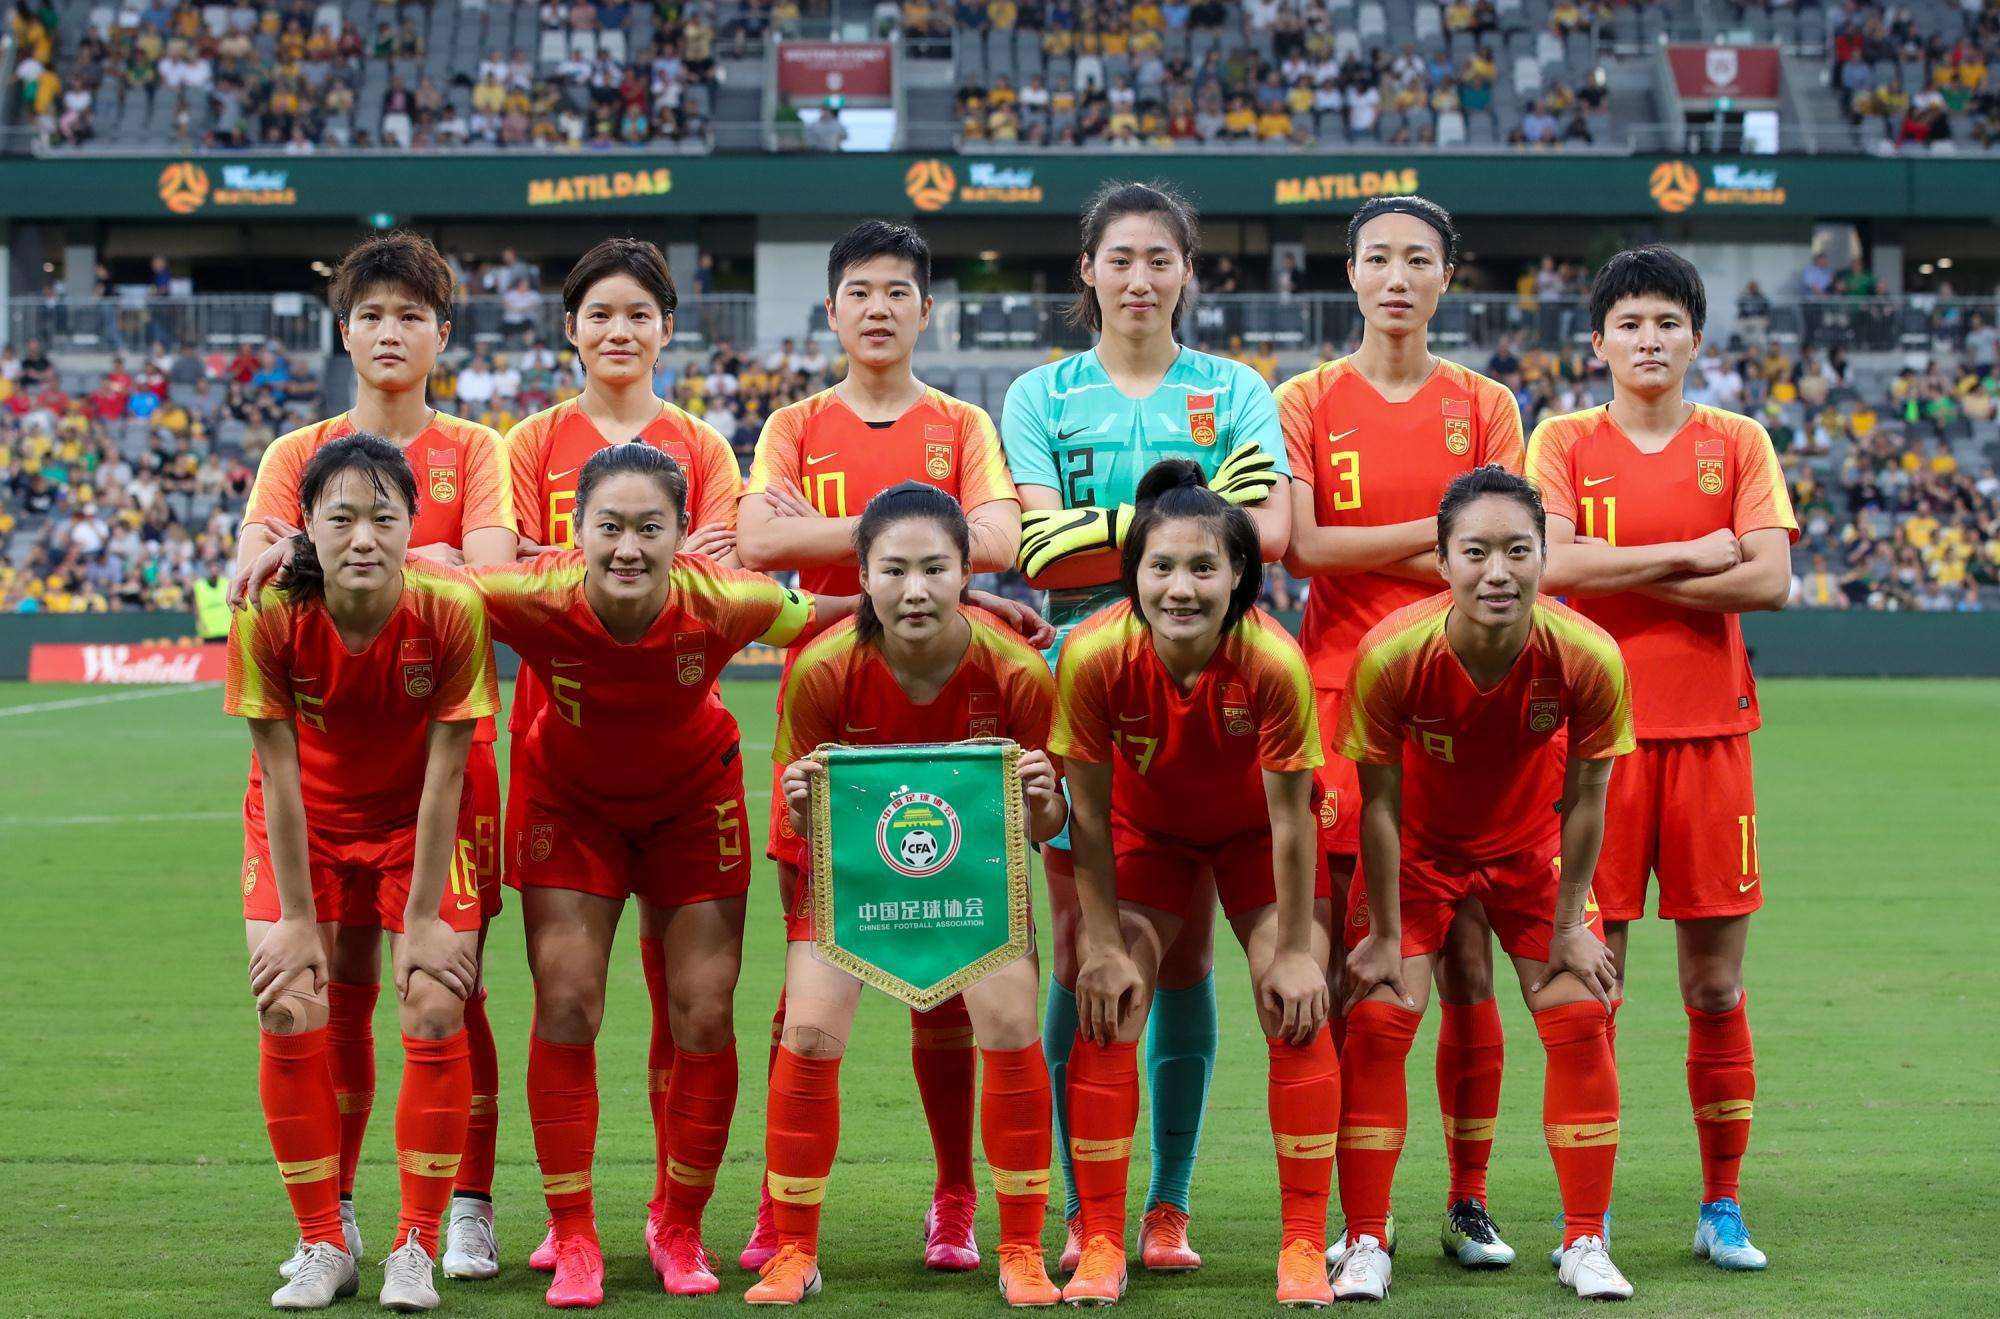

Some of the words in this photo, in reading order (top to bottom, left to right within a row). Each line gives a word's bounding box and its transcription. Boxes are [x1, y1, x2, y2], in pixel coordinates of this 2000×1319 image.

[528, 168, 671, 206] MATILDAS
[1275, 168, 1419, 205] MATILDAS
[1191, 414, 1213, 423] CFA
[1448, 421, 1468, 430] CFA
[928, 444, 950, 454] CFA
[1699, 461, 1722, 469] CFA
[432, 470, 455, 478] CFA
[1330, 451, 1362, 511] 3
[1580, 496, 1616, 547] 11
[679, 653, 703, 664] CFA
[406, 665, 431, 674] CFA
[551, 675, 582, 728] 5
[972, 719, 995, 729] CFA
[715, 799, 742, 856] 5
[907, 843, 931, 854] CFA
[450, 838, 479, 898] 16
[858, 897, 984, 922] 中国足球协会
[859, 923, 890, 932] CHINESE
[894, 922, 933, 930] FOOTBALL
[935, 920, 984, 928] ASSOCIATION
